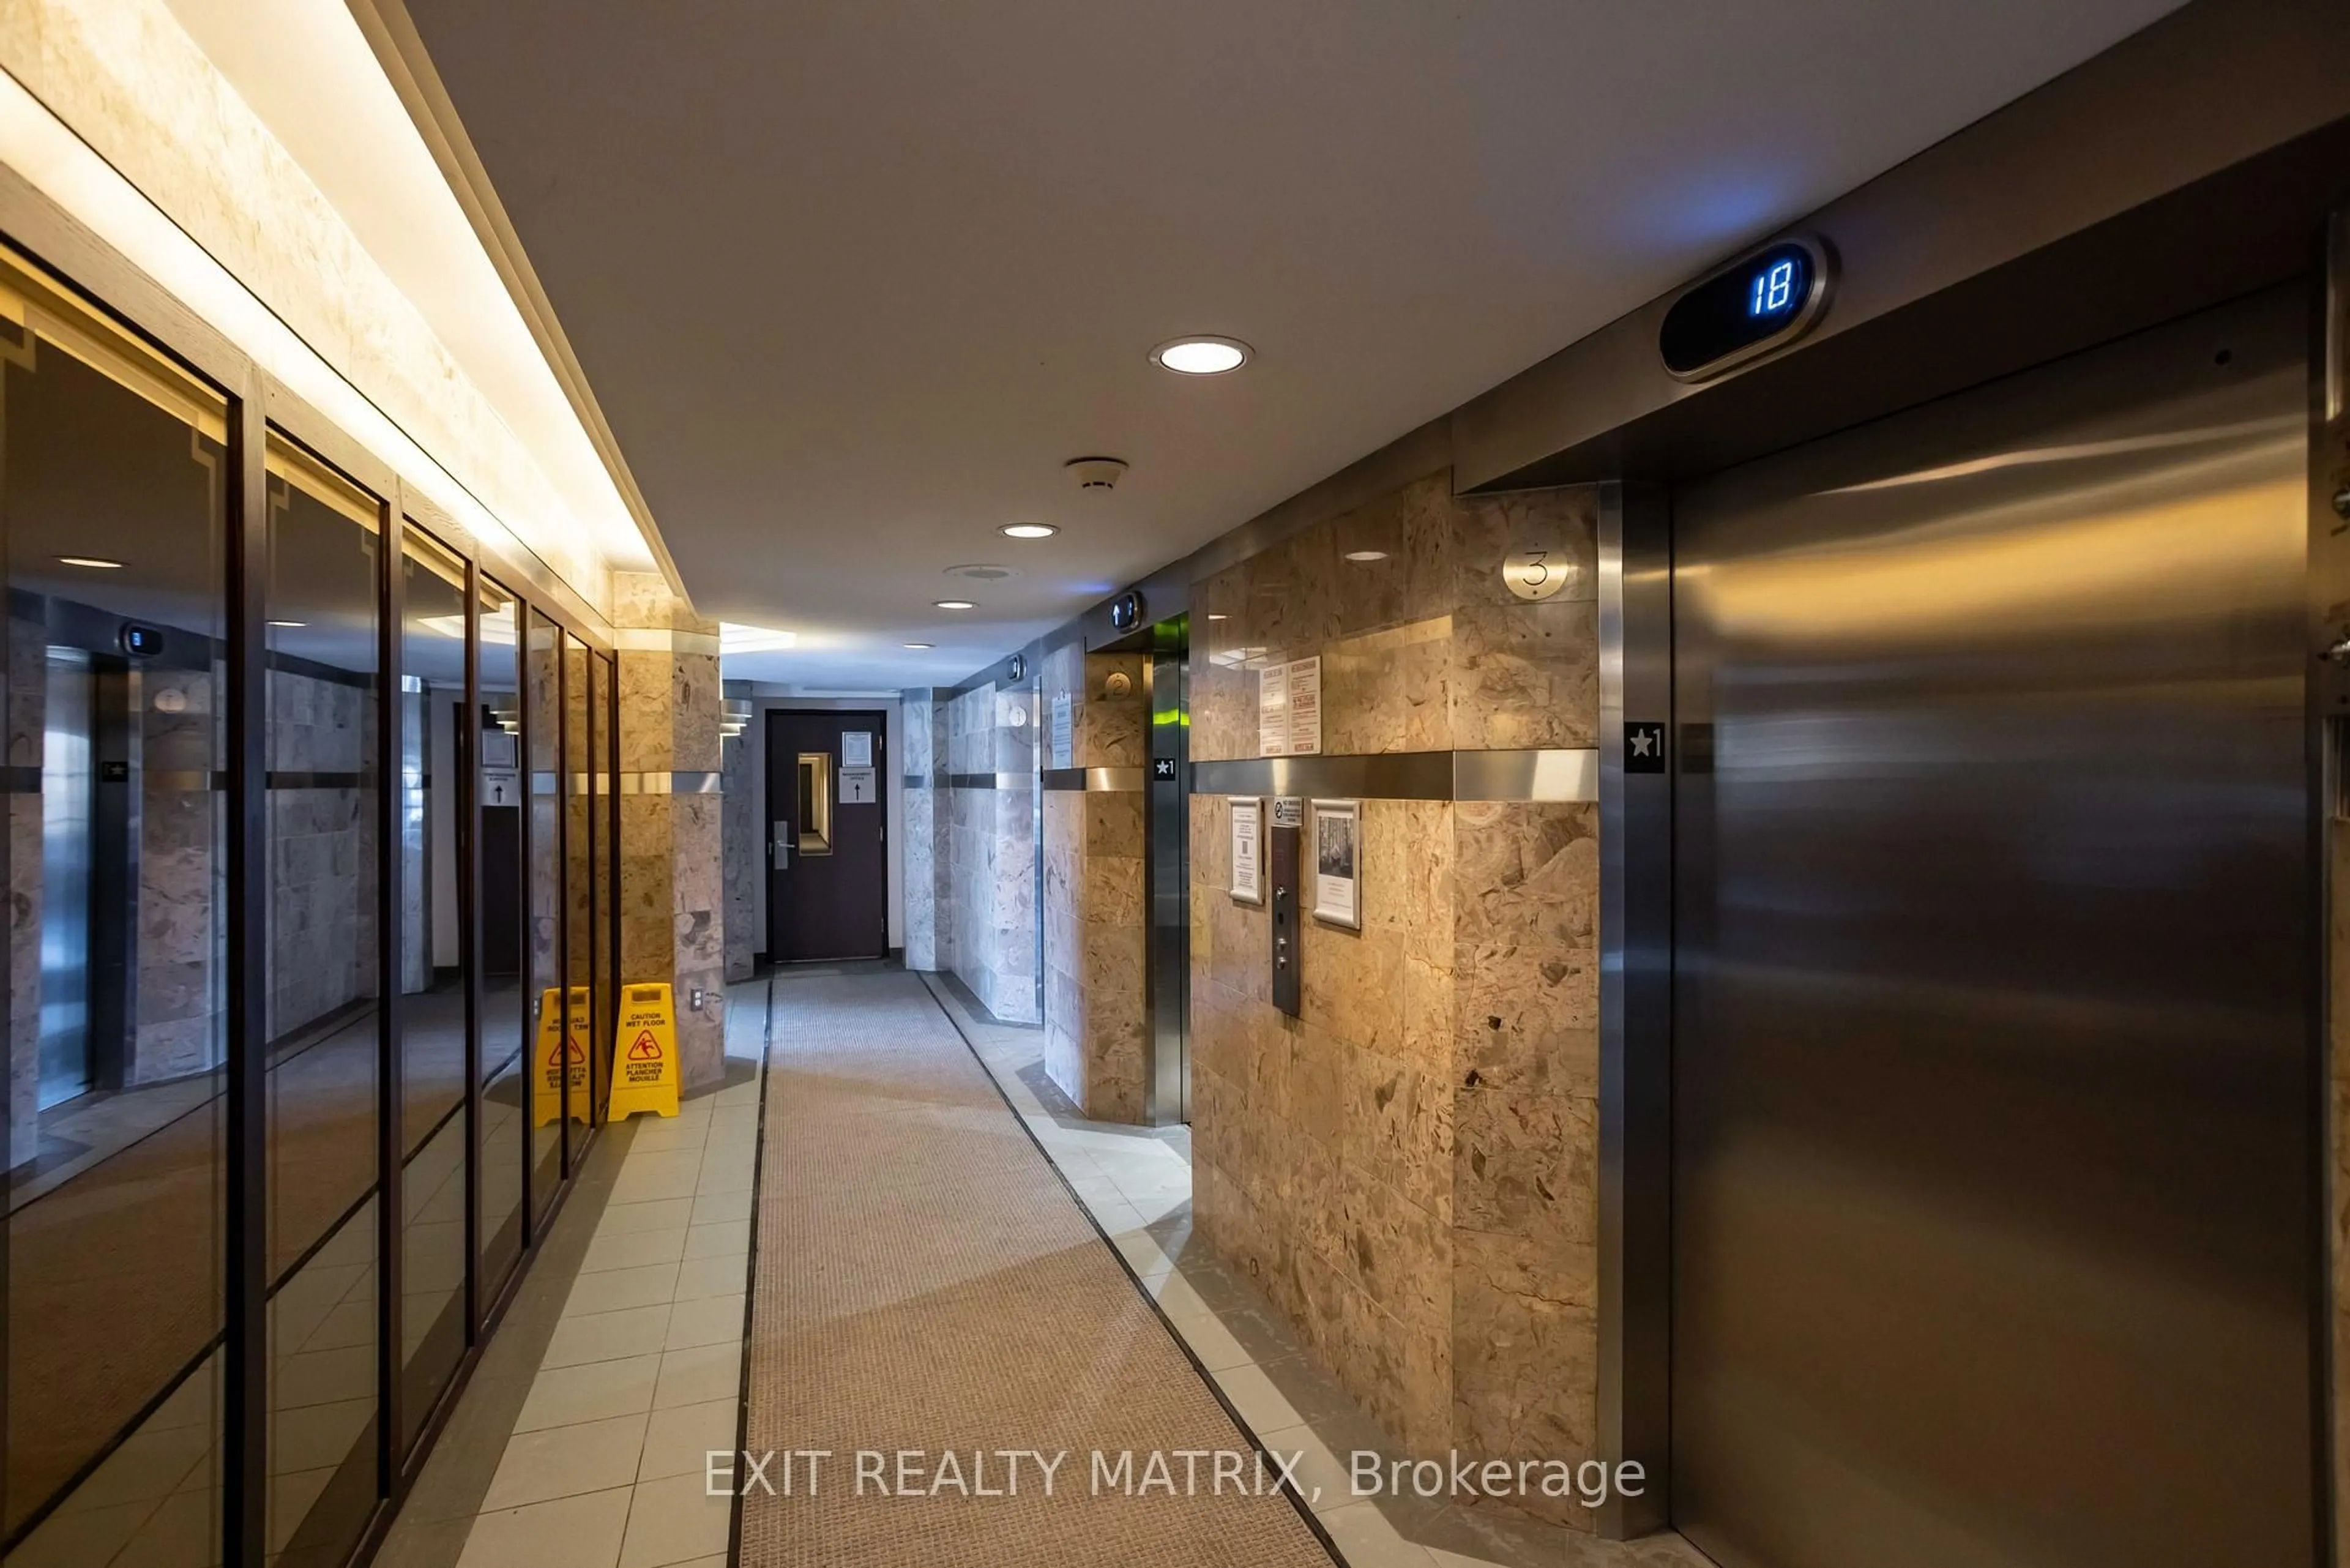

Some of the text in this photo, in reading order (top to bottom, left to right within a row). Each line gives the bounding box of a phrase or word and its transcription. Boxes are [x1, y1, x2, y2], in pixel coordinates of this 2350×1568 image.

[1755, 261, 1792, 315] 18
[1523, 551, 1548, 586] 3
[1113, 679, 1124, 696] 2
[1653, 728, 1662, 757] 1
